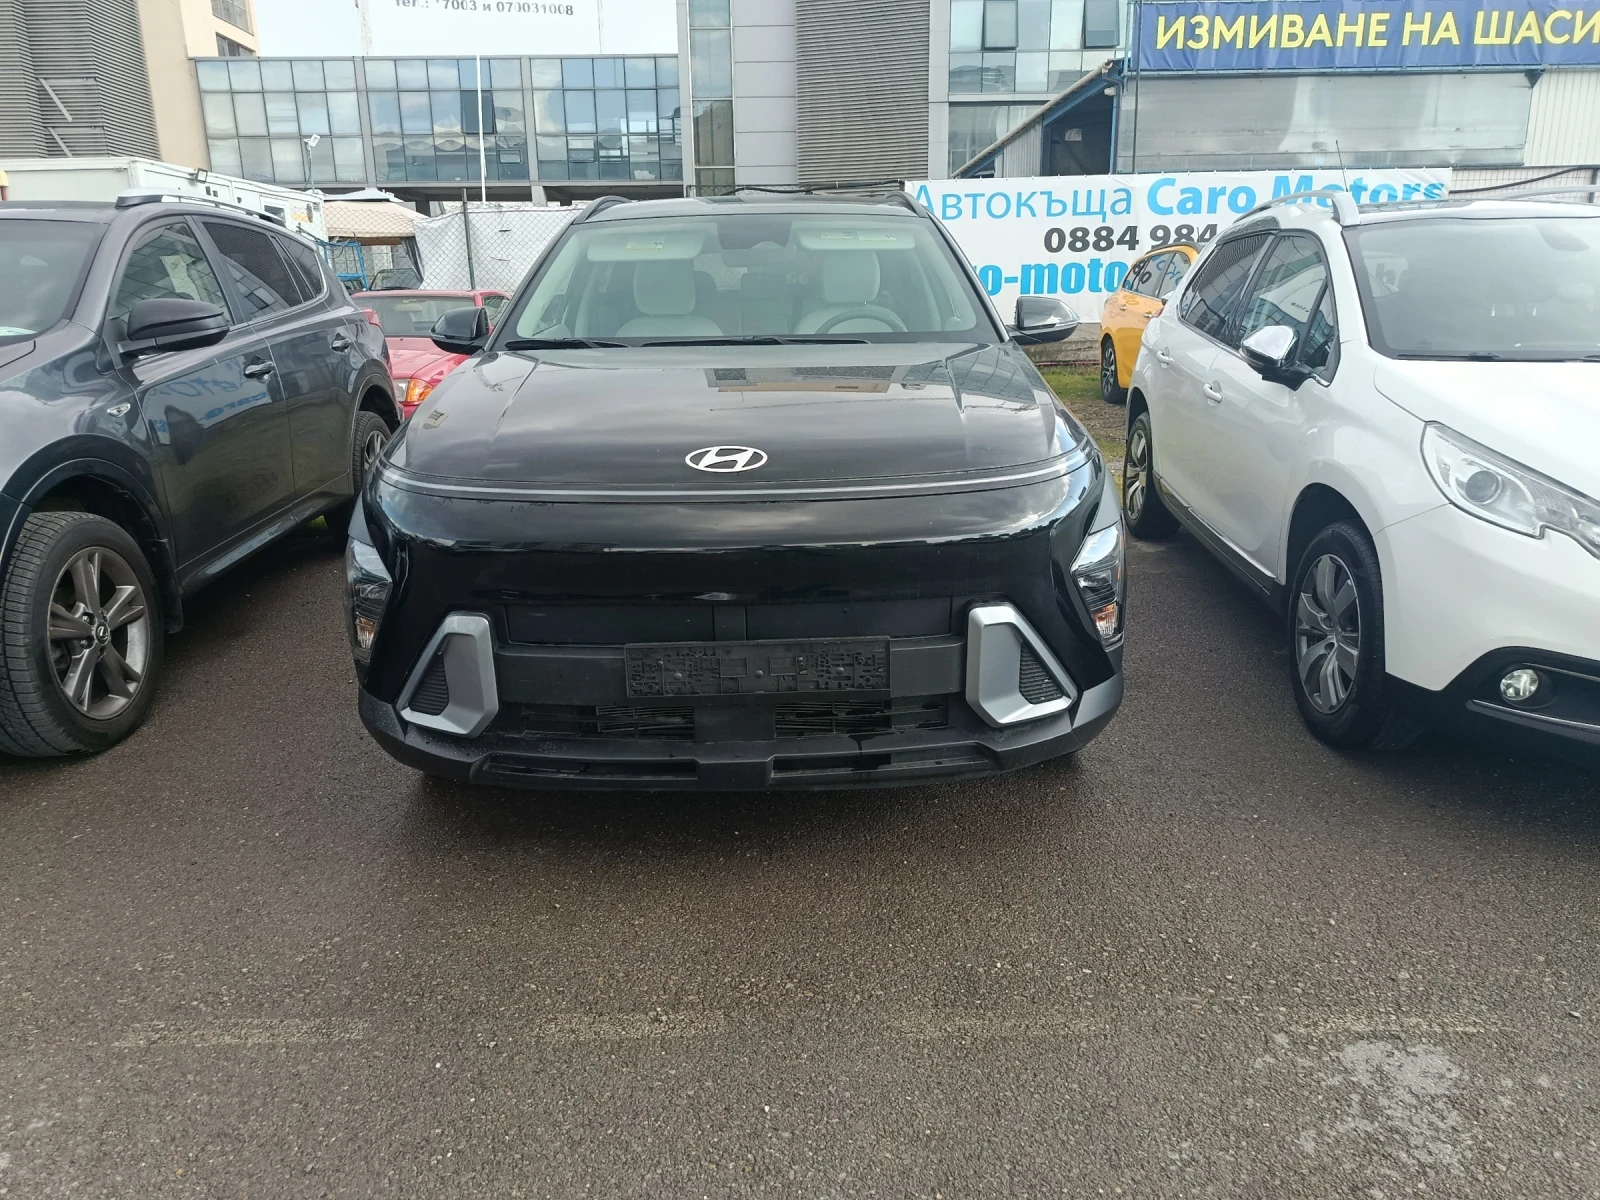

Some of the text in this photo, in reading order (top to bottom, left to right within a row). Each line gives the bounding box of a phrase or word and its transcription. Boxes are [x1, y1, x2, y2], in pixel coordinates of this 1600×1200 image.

[496, 1, 574, 16] 070031008
[1155, 9, 1600, 50] ИЗМИВАНЕ НА ШАСИ
[914, 174, 1445, 223] Автокъща Caro Motors
[1043, 223, 1218, 253] 0884 984
